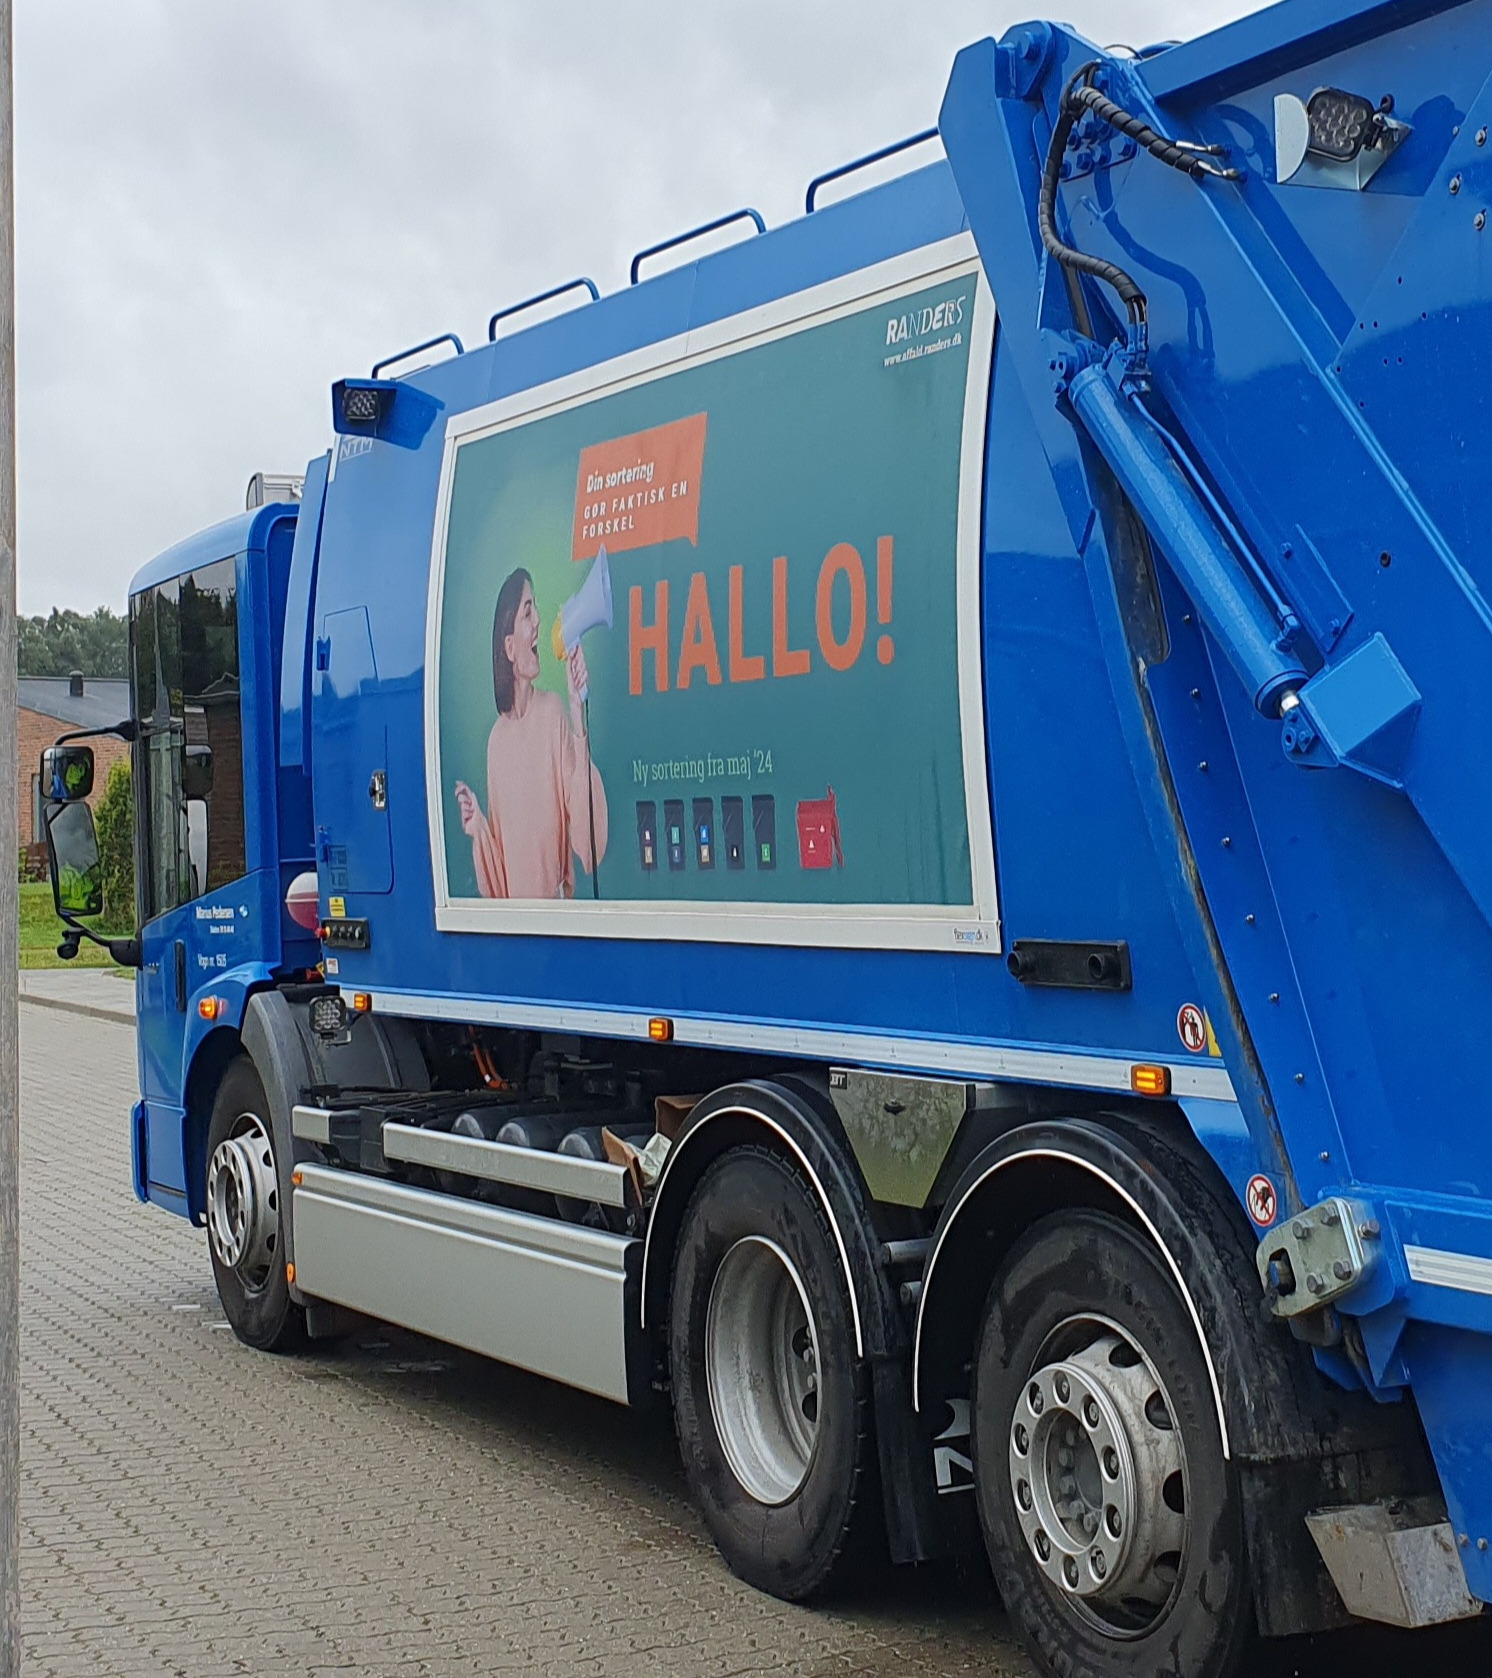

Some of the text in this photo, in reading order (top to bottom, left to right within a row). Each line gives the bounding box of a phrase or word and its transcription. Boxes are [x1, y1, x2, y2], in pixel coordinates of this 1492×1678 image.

[886, 295, 967, 345] RANDERS
[586, 458, 655, 493] Din sortering
[584, 480, 687, 519] GØR FAKTISK EN
[582, 515, 635, 540] FORSKEL
[629, 534, 894, 695] HALLO!
[632, 759, 649, 787] Ny
[651, 755, 704, 783] sortering
[708, 752, 725, 777] fra
[728, 750, 751, 780] maj
